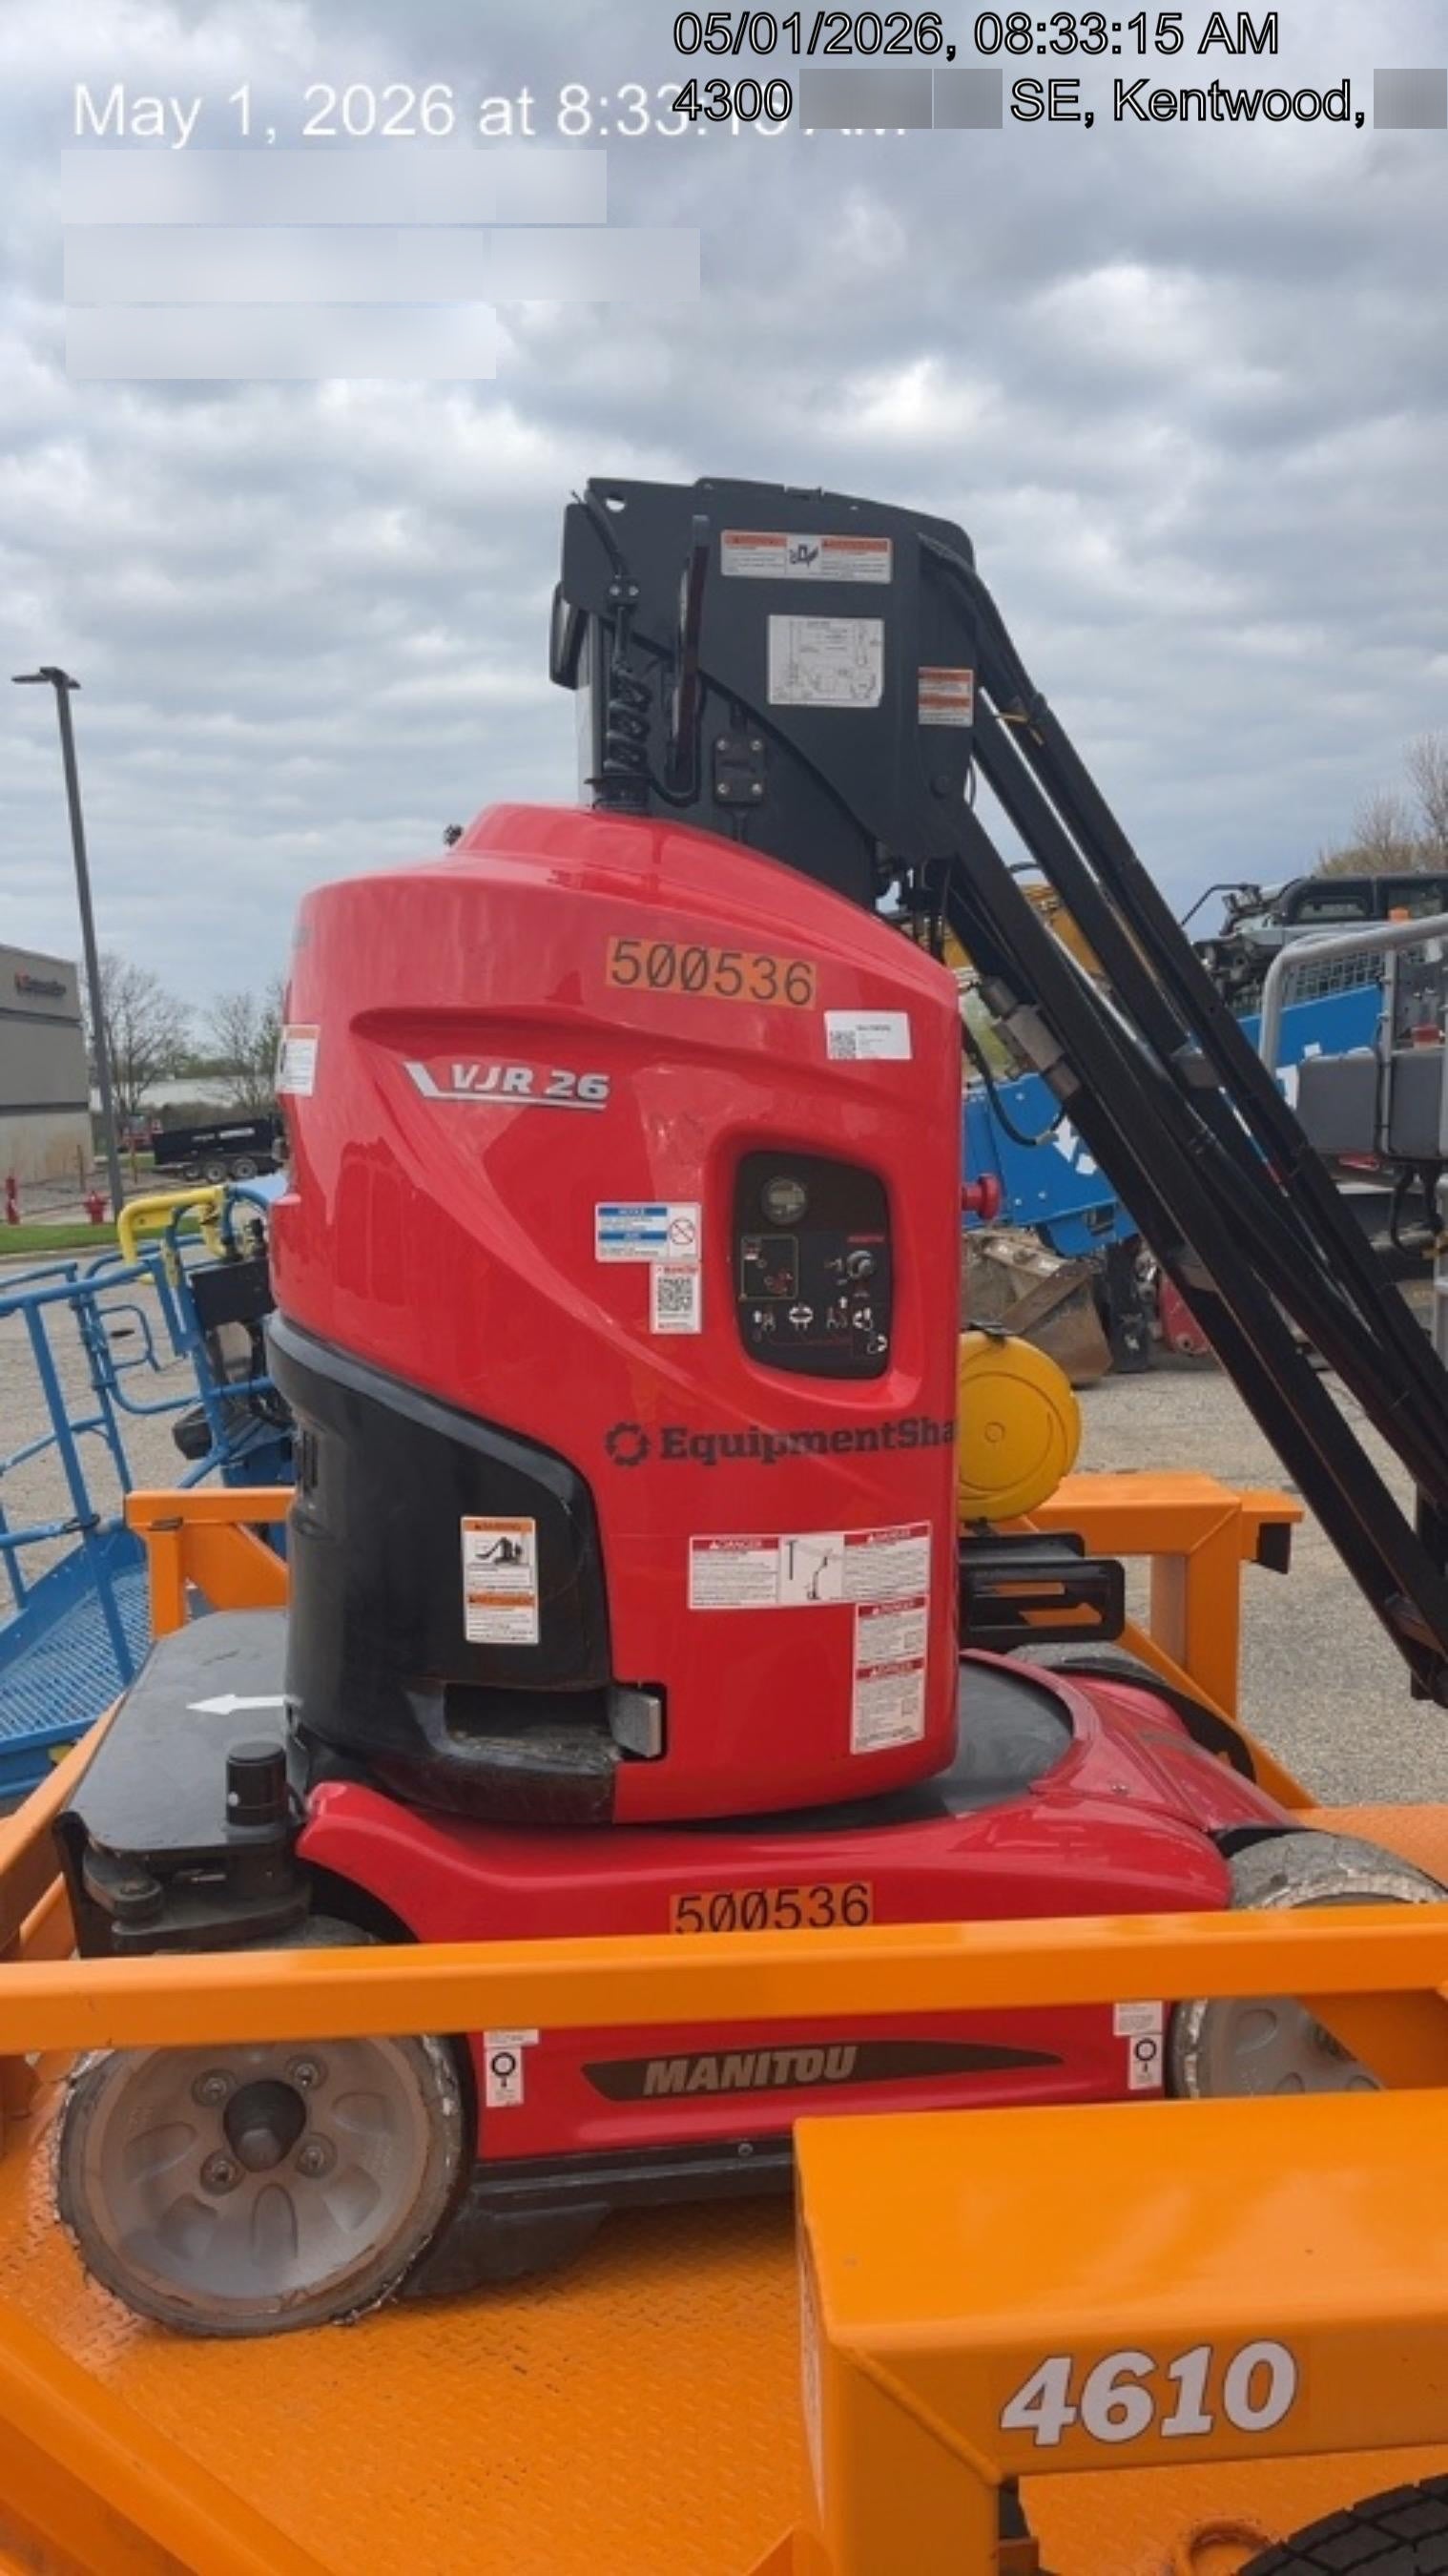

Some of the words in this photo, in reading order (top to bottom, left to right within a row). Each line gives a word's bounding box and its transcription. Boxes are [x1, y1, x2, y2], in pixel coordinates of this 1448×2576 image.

[611, 940, 813, 1007] 500536
[451, 1063, 534, 1095] VJR
[545, 1069, 610, 1099] 26
[675, 1882, 869, 1934] 500536
[642, 2045, 858, 2096] MANITOU
[1000, 2337, 1298, 2447] 4610
